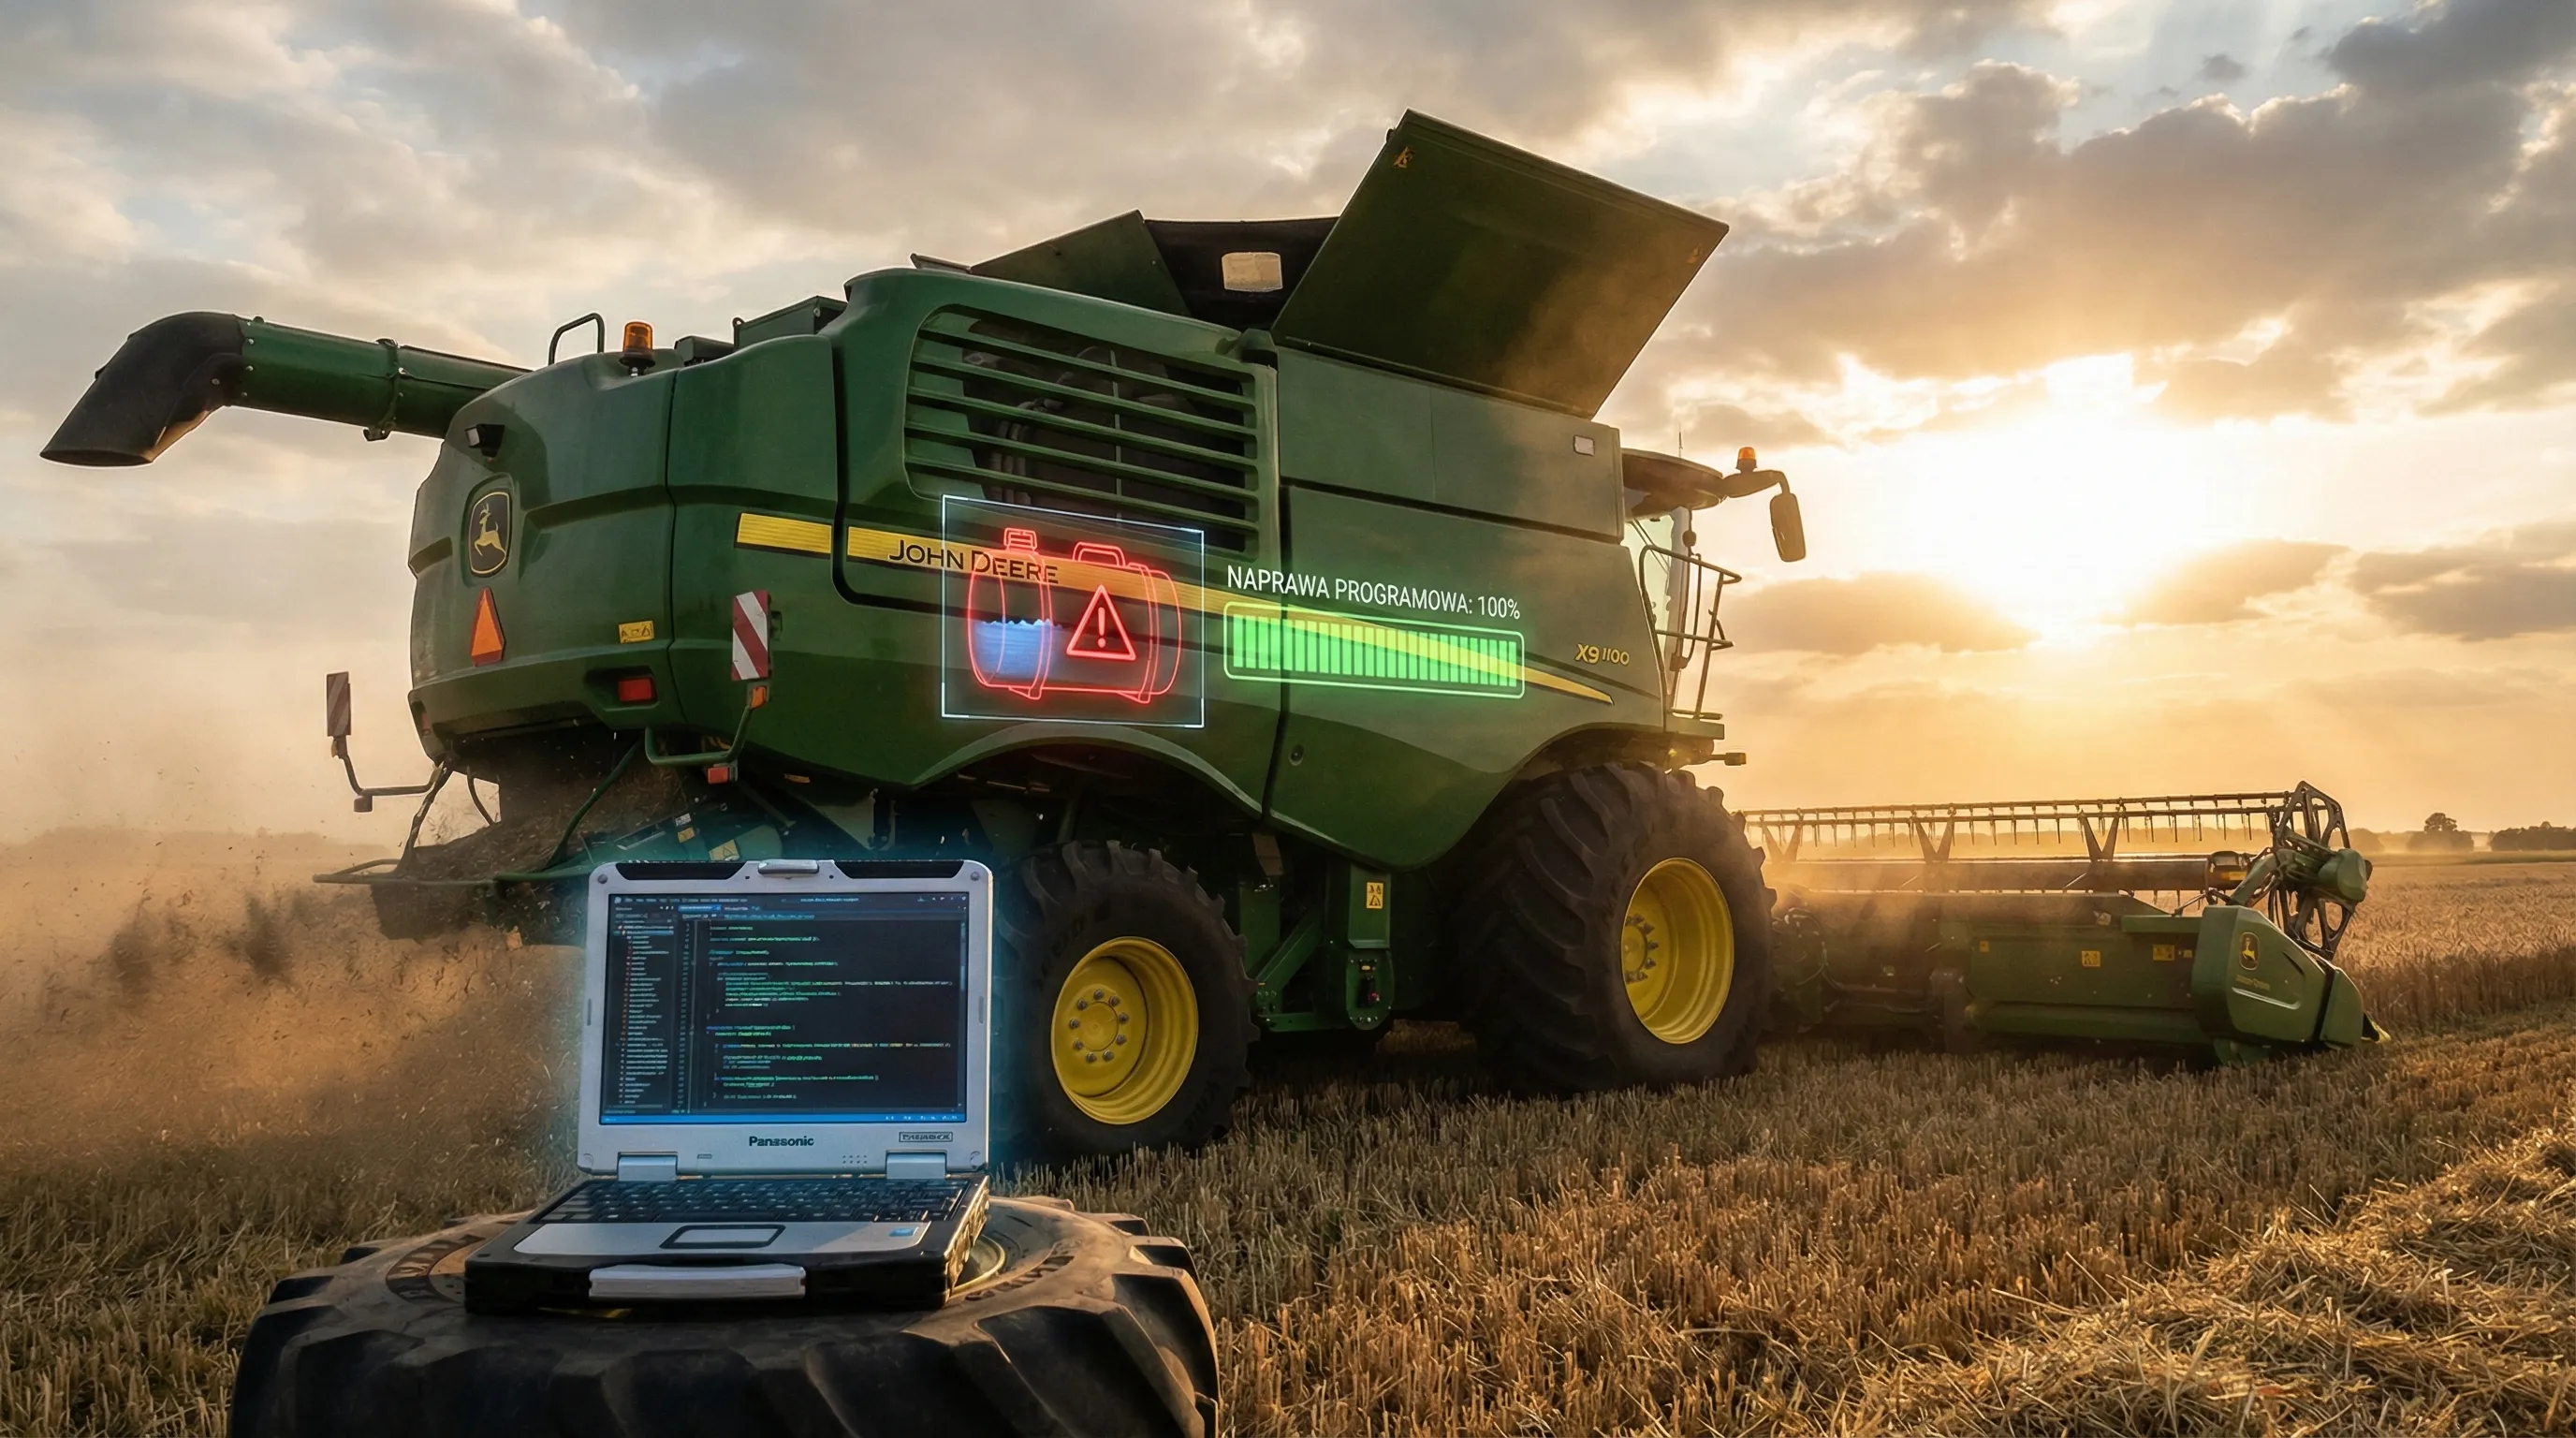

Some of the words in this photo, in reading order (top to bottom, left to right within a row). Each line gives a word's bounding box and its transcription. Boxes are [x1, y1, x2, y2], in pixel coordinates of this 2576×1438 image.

[888, 539, 964, 570] JOHN
[971, 550, 1060, 584] DEERE
[1574, 643, 1600, 664] X9
[1602, 647, 1630, 666] 1100
